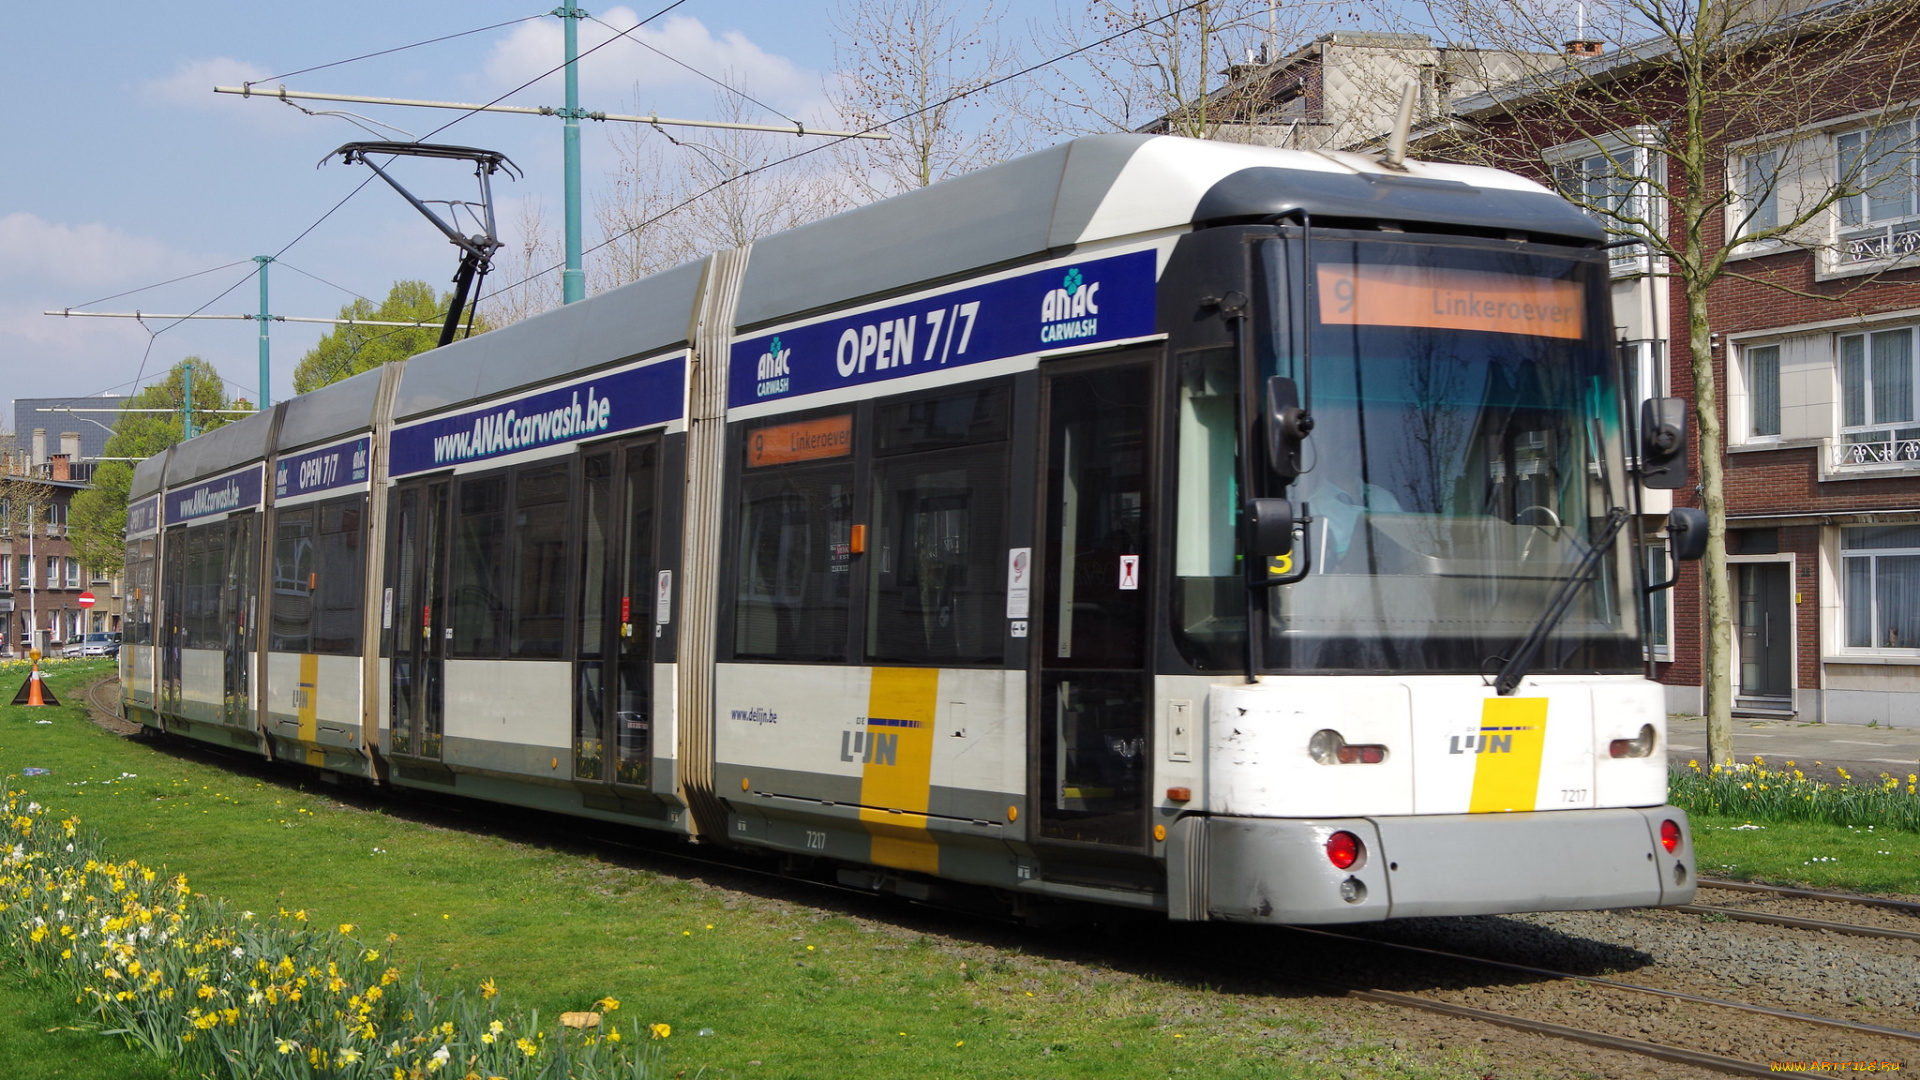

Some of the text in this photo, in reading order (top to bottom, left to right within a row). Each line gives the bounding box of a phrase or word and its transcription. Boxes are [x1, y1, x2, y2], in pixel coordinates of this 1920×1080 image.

[1334, 278, 1574, 323] 9 Linkeroever
[836, 301, 980, 378] OPEN 7/7
[1040, 318, 1098, 344] CARWASH
[757, 378, 789, 397] CARWASH
[434, 386, 611, 464] www.ANACcarwash.be
[754, 427, 851, 457] 9 Linkeroever
[300, 453, 339, 489] OPEN 7/7
[731, 708, 777, 726] www.delijn.be
[856, 717, 866, 726] DE
[840, 730, 899, 766] LIJN
[1449, 734, 1513, 754] LIJN
[1561, 789, 1587, 803] 7217
[806, 831, 826, 849] 7217
